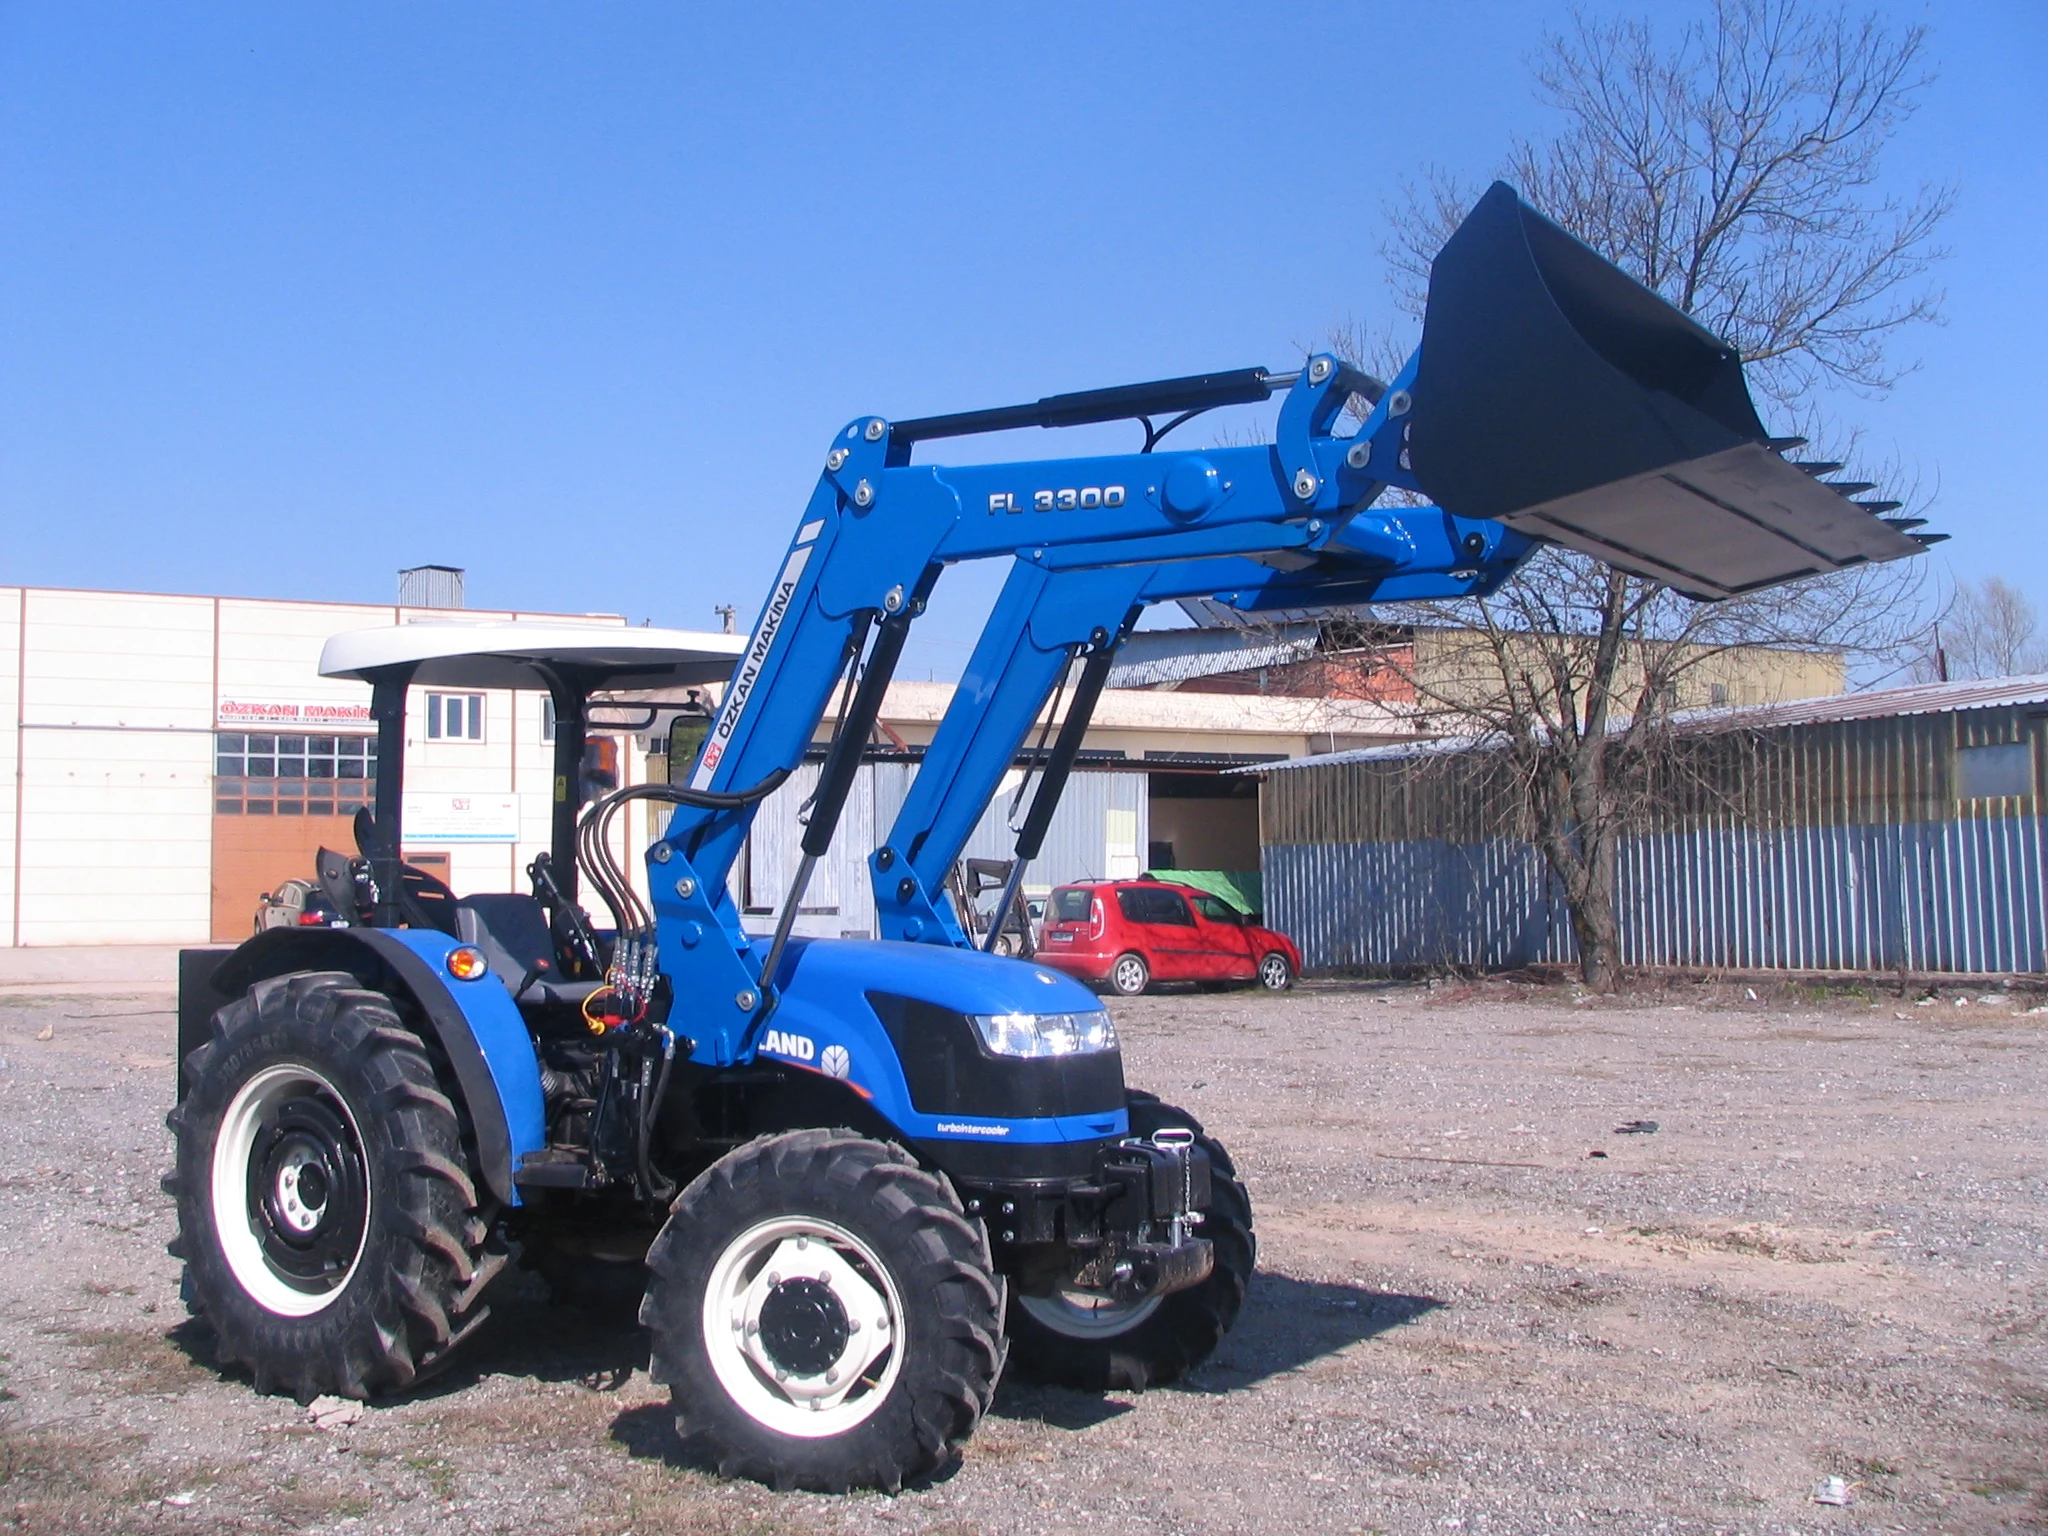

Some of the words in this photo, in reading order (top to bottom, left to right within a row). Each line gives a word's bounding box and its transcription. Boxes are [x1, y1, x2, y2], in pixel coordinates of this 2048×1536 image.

[988, 493, 1023, 516] FL
[1034, 485, 1125, 512] 3300
[717, 665, 757, 739] ÖZKAN
[754, 581, 795, 663] MAKİNA
[220, 700, 299, 716] ÖZKAN
[937, 1122, 1010, 1136] turbointercooler
